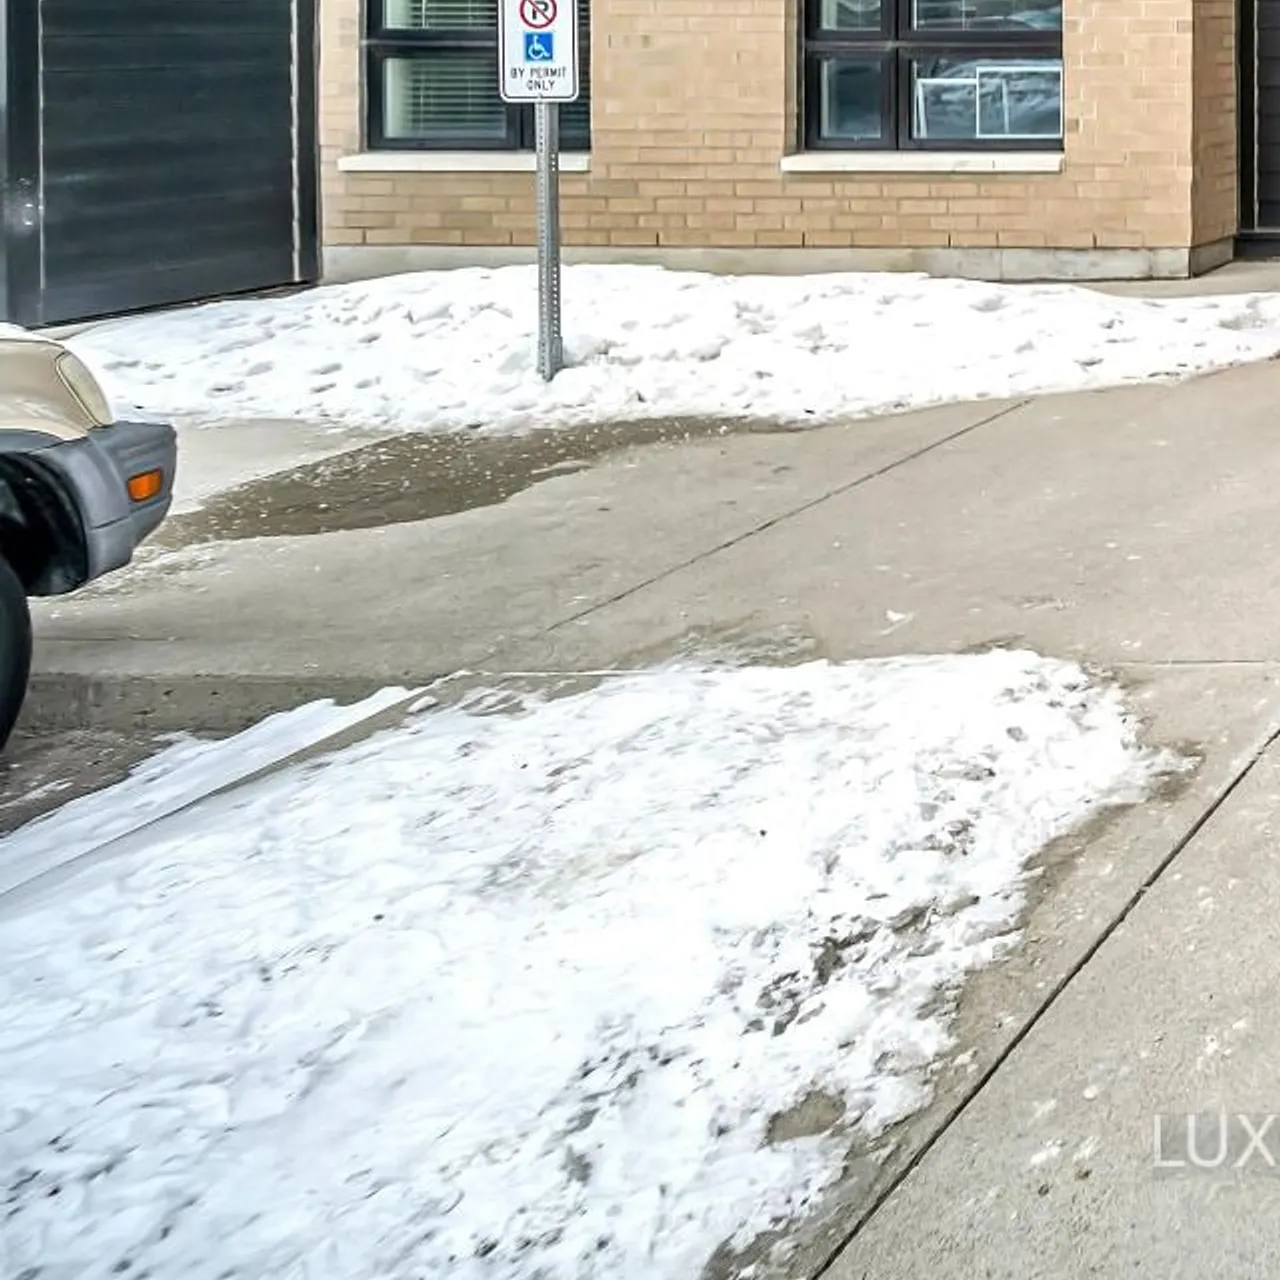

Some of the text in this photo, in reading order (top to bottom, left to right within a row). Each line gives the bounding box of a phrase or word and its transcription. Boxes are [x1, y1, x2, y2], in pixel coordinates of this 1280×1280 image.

[510, 67, 567, 79] BY PERMIT
[526, 80, 556, 91] ONLY
